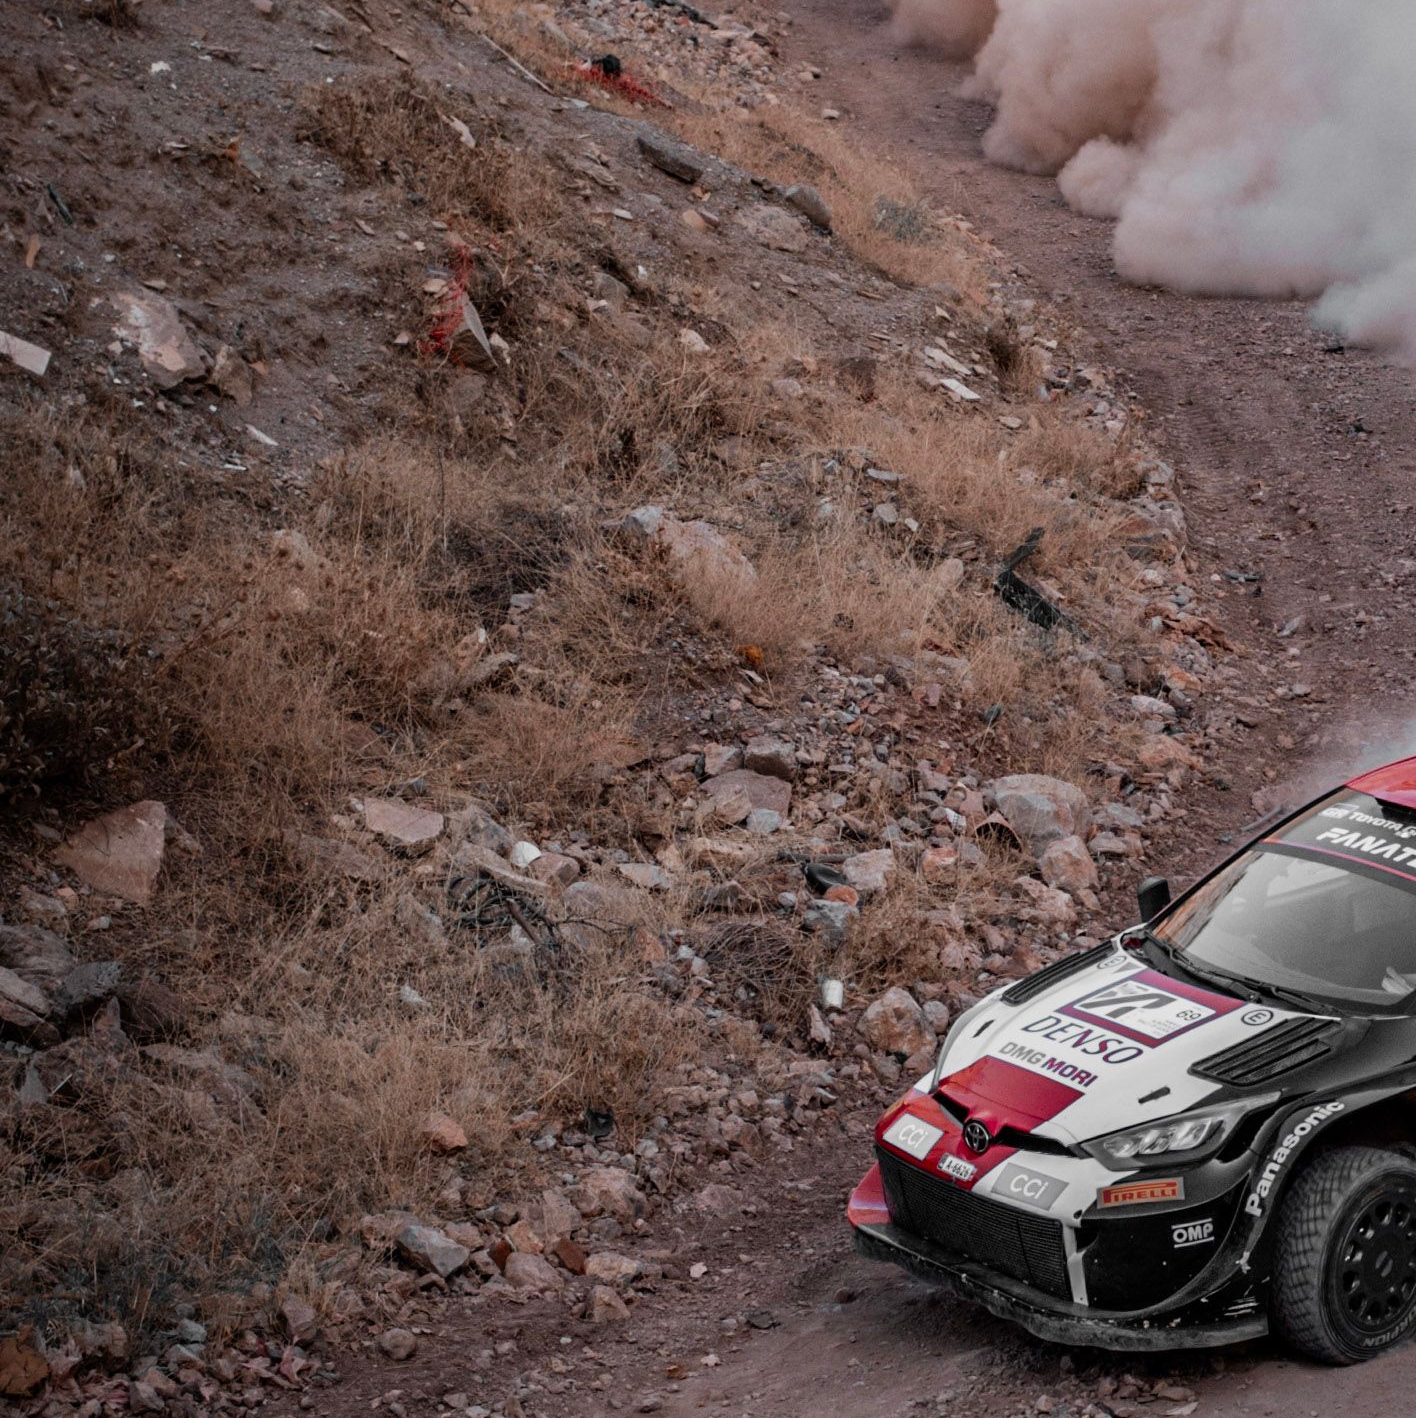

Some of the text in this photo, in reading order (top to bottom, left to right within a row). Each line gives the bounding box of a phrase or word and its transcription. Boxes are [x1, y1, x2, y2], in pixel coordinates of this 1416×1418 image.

[1349, 811, 1404, 834] TOYOTA
[1175, 1008, 1202, 1022] 69
[1021, 1015, 1144, 1064] DENSO
[999, 1041, 1098, 1088] DMG MORI
[1244, 1101, 1345, 1217] Panasonic
[1103, 1181, 1178, 1204] PIRELLI
[1172, 1223, 1214, 1244] OMP
